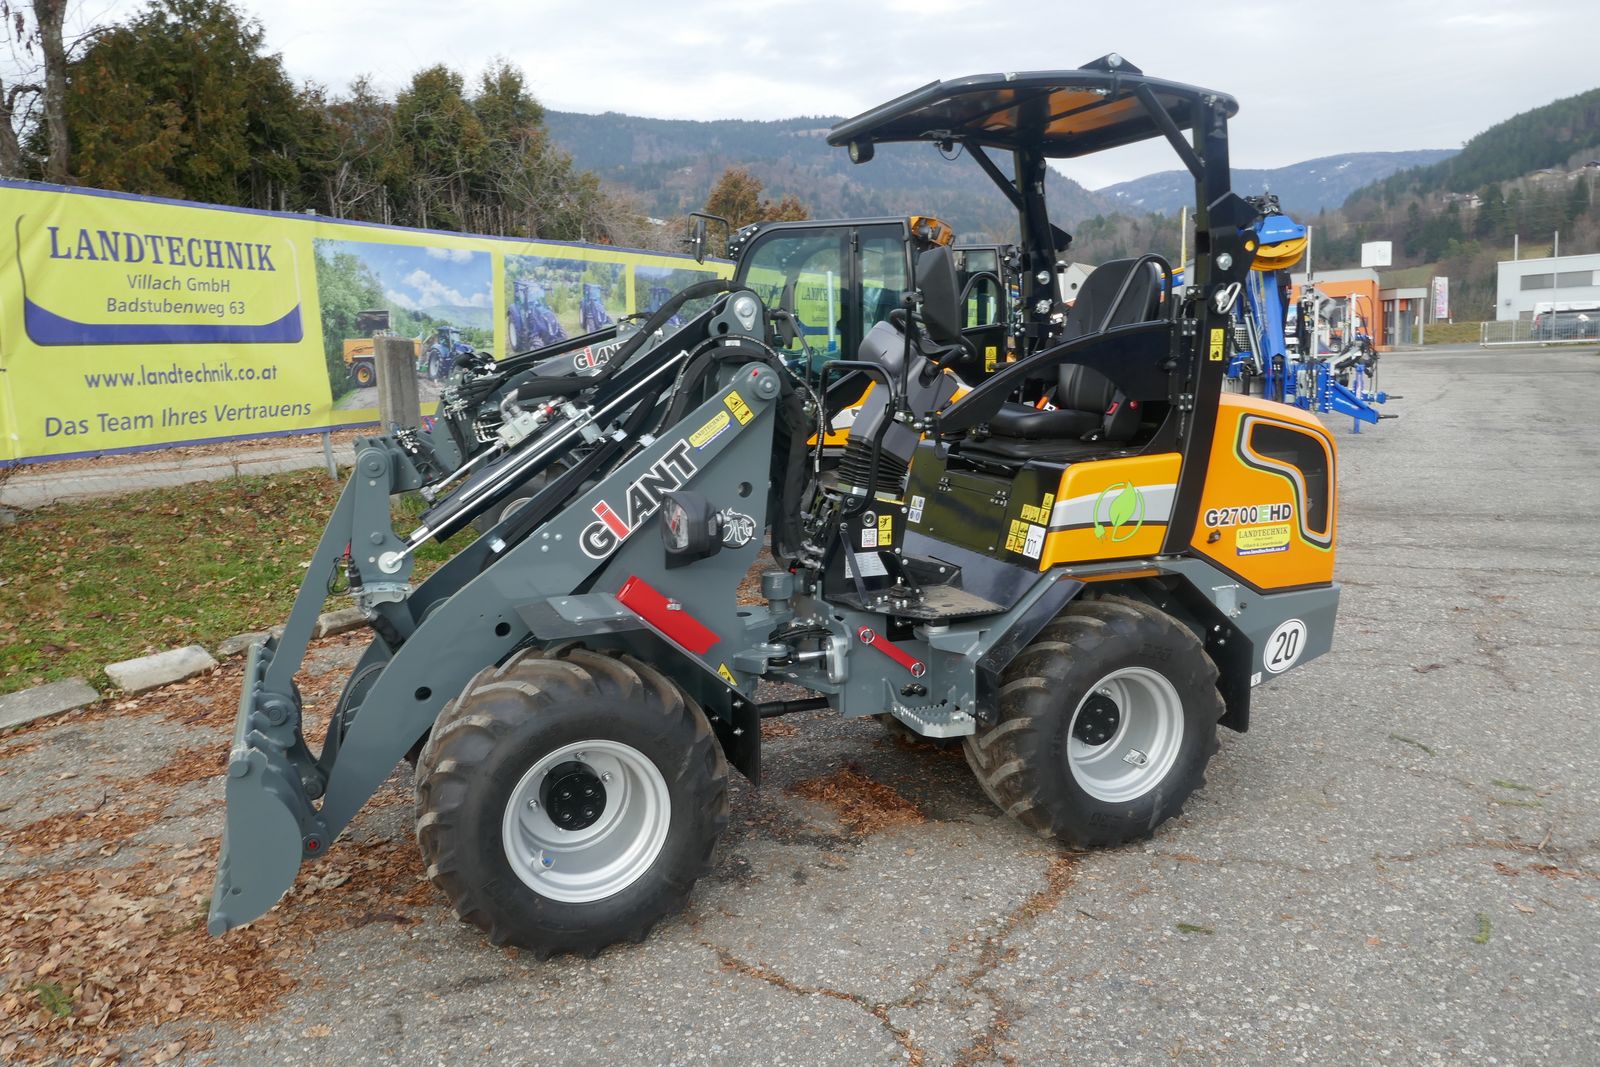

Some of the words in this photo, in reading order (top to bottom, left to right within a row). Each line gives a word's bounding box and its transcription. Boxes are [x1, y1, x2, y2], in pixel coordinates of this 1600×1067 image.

[47, 226, 276, 272] LANDTECHNIK
[127, 274, 182, 291] Villach
[187, 277, 230, 293] GmbH
[106, 298, 225, 318] Badstubenweg
[229, 301, 245, 315] 63
[84, 363, 277, 389] www.landtechnik.co.at
[45, 417, 89, 437] Das
[96, 412, 154, 433] Team
[161, 407, 207, 427] Ihres
[214, 402, 312, 423] Vertrauens
[1205, 503, 1292, 527] G2700EHD
[1271, 628, 1299, 665] 20
